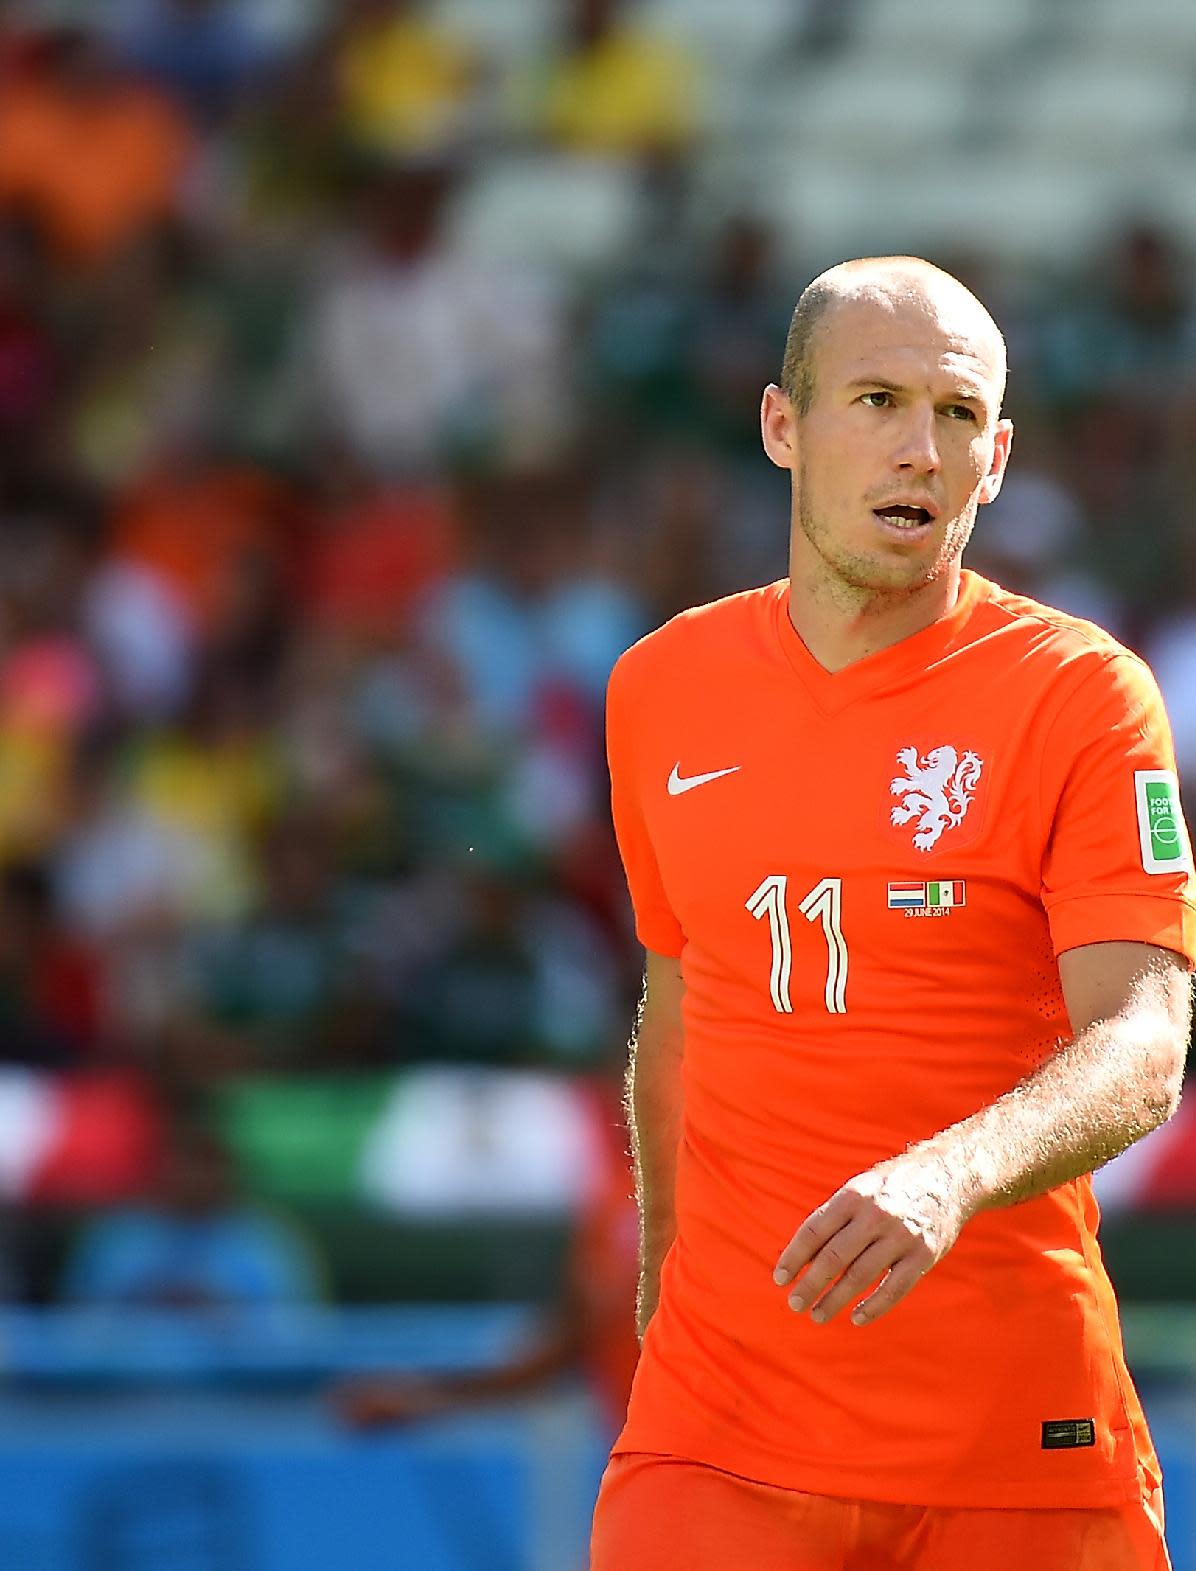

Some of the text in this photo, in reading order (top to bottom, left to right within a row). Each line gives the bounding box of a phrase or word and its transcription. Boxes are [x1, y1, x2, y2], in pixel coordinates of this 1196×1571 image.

[1151, 806, 1169, 815] FOR
[904, 906, 950, 918] 29 JUNE 2014
[745, 875, 848, 1014] 11
